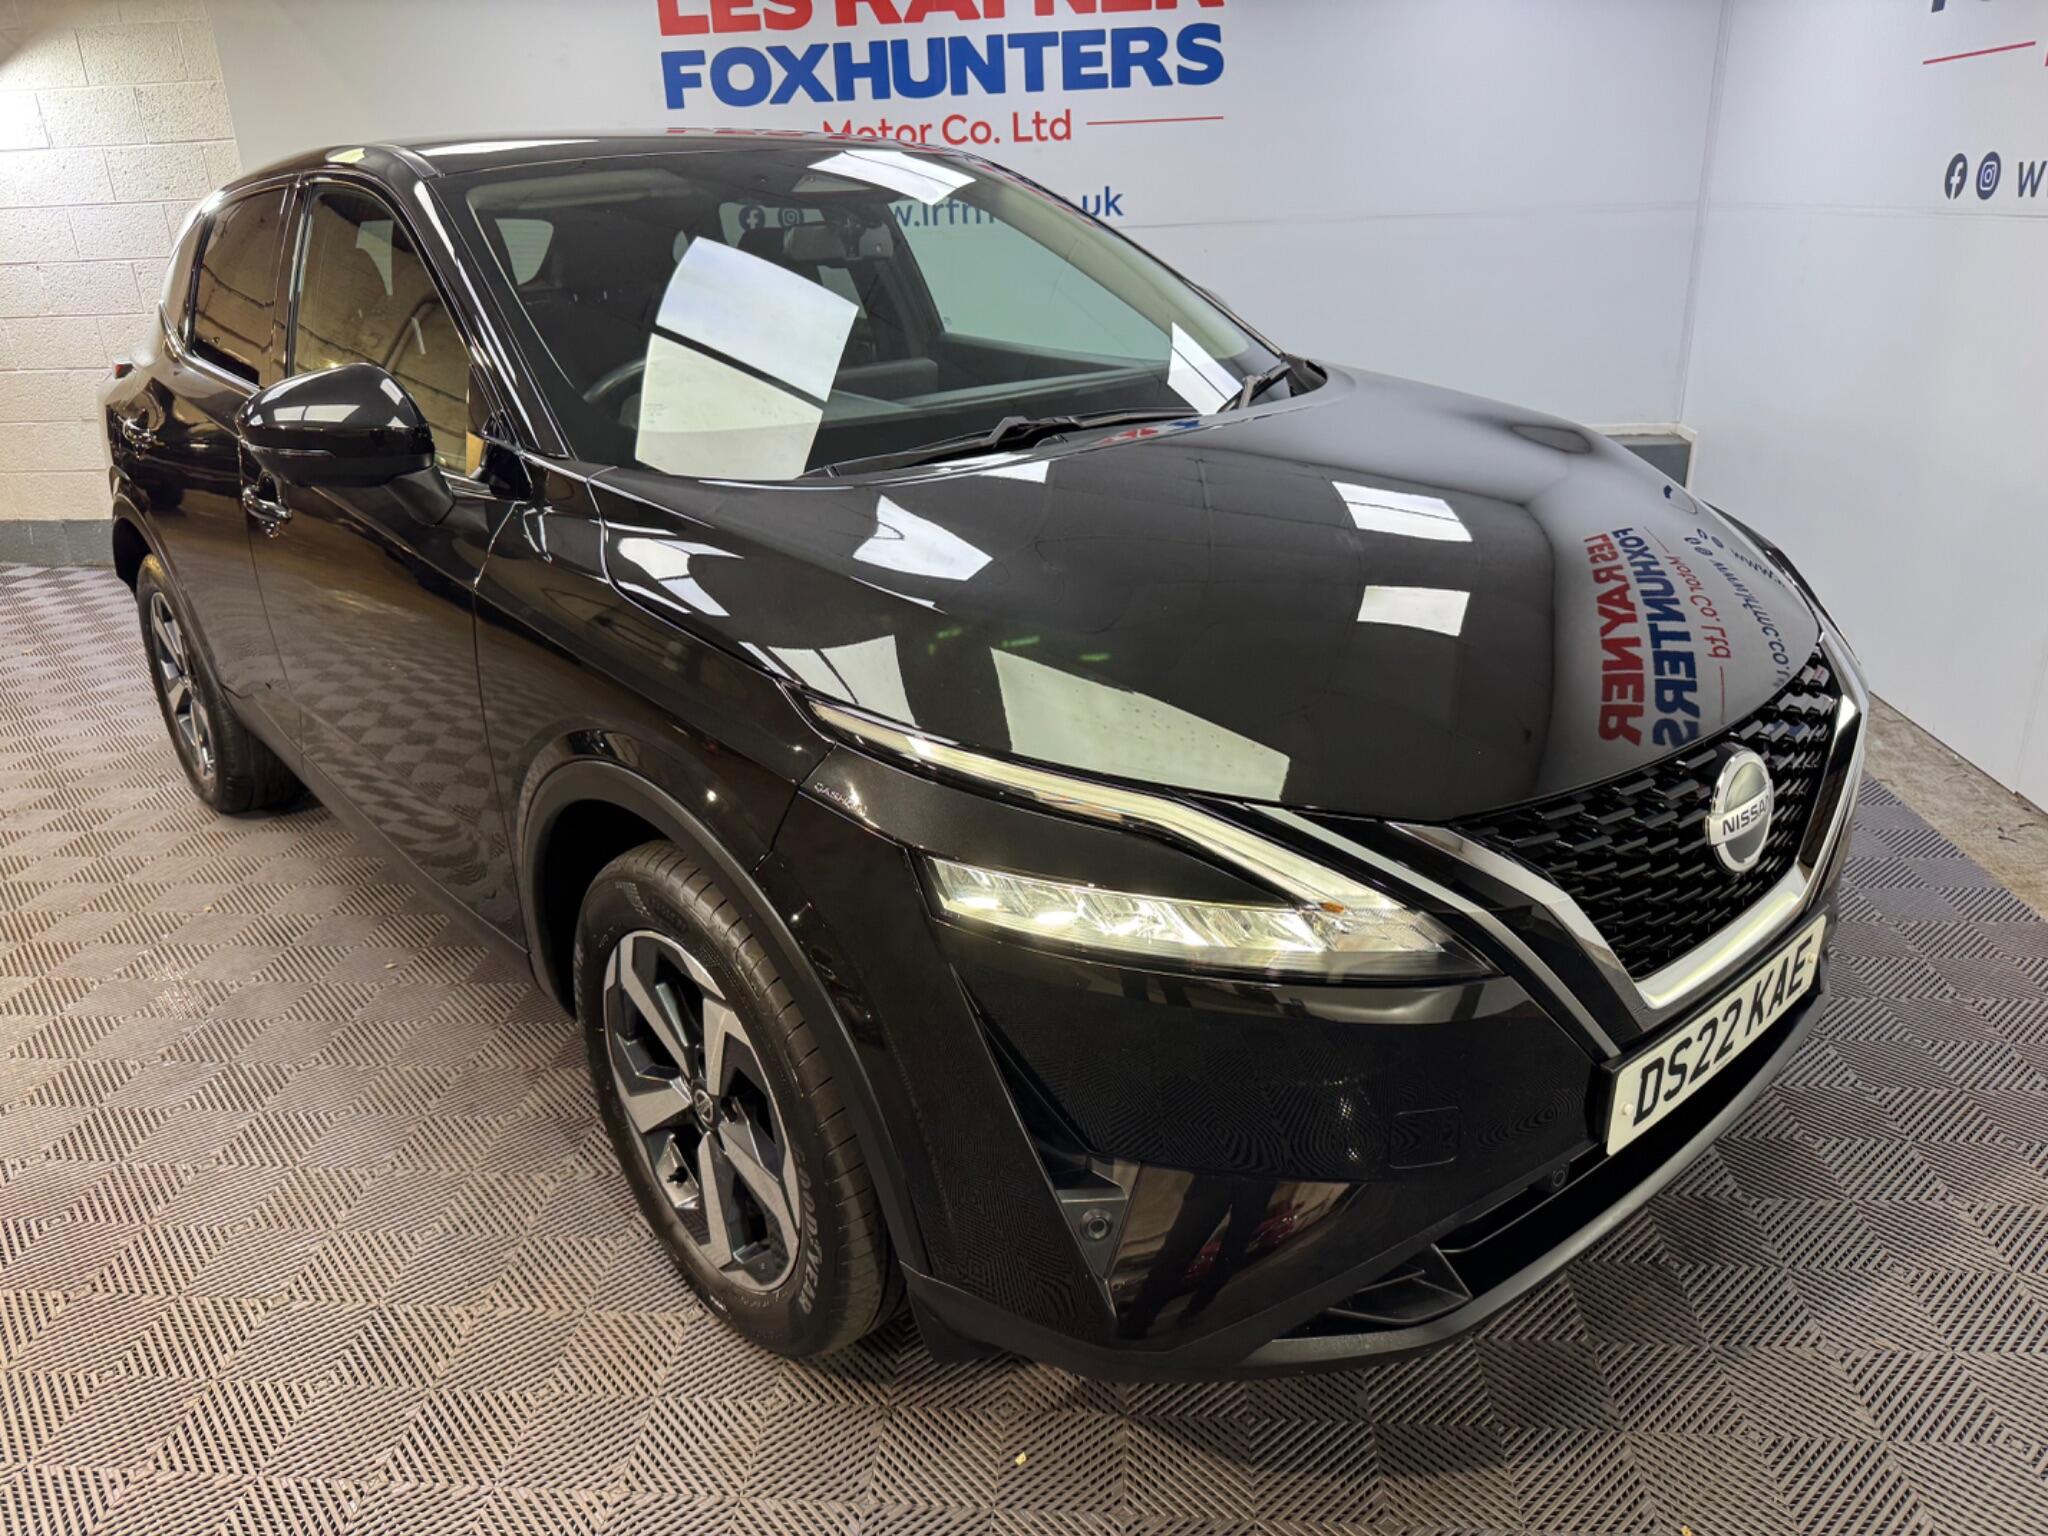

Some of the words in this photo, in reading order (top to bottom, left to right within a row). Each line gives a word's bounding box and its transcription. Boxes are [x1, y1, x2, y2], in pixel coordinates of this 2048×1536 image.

[660, 22, 1225, 109] FOXHUNTERS
[942, 114, 1001, 146] Co.
[1011, 108, 1072, 143] Ltd
[1632, 997, 1744, 1128] DS22
[1745, 933, 1814, 1037] KAE
